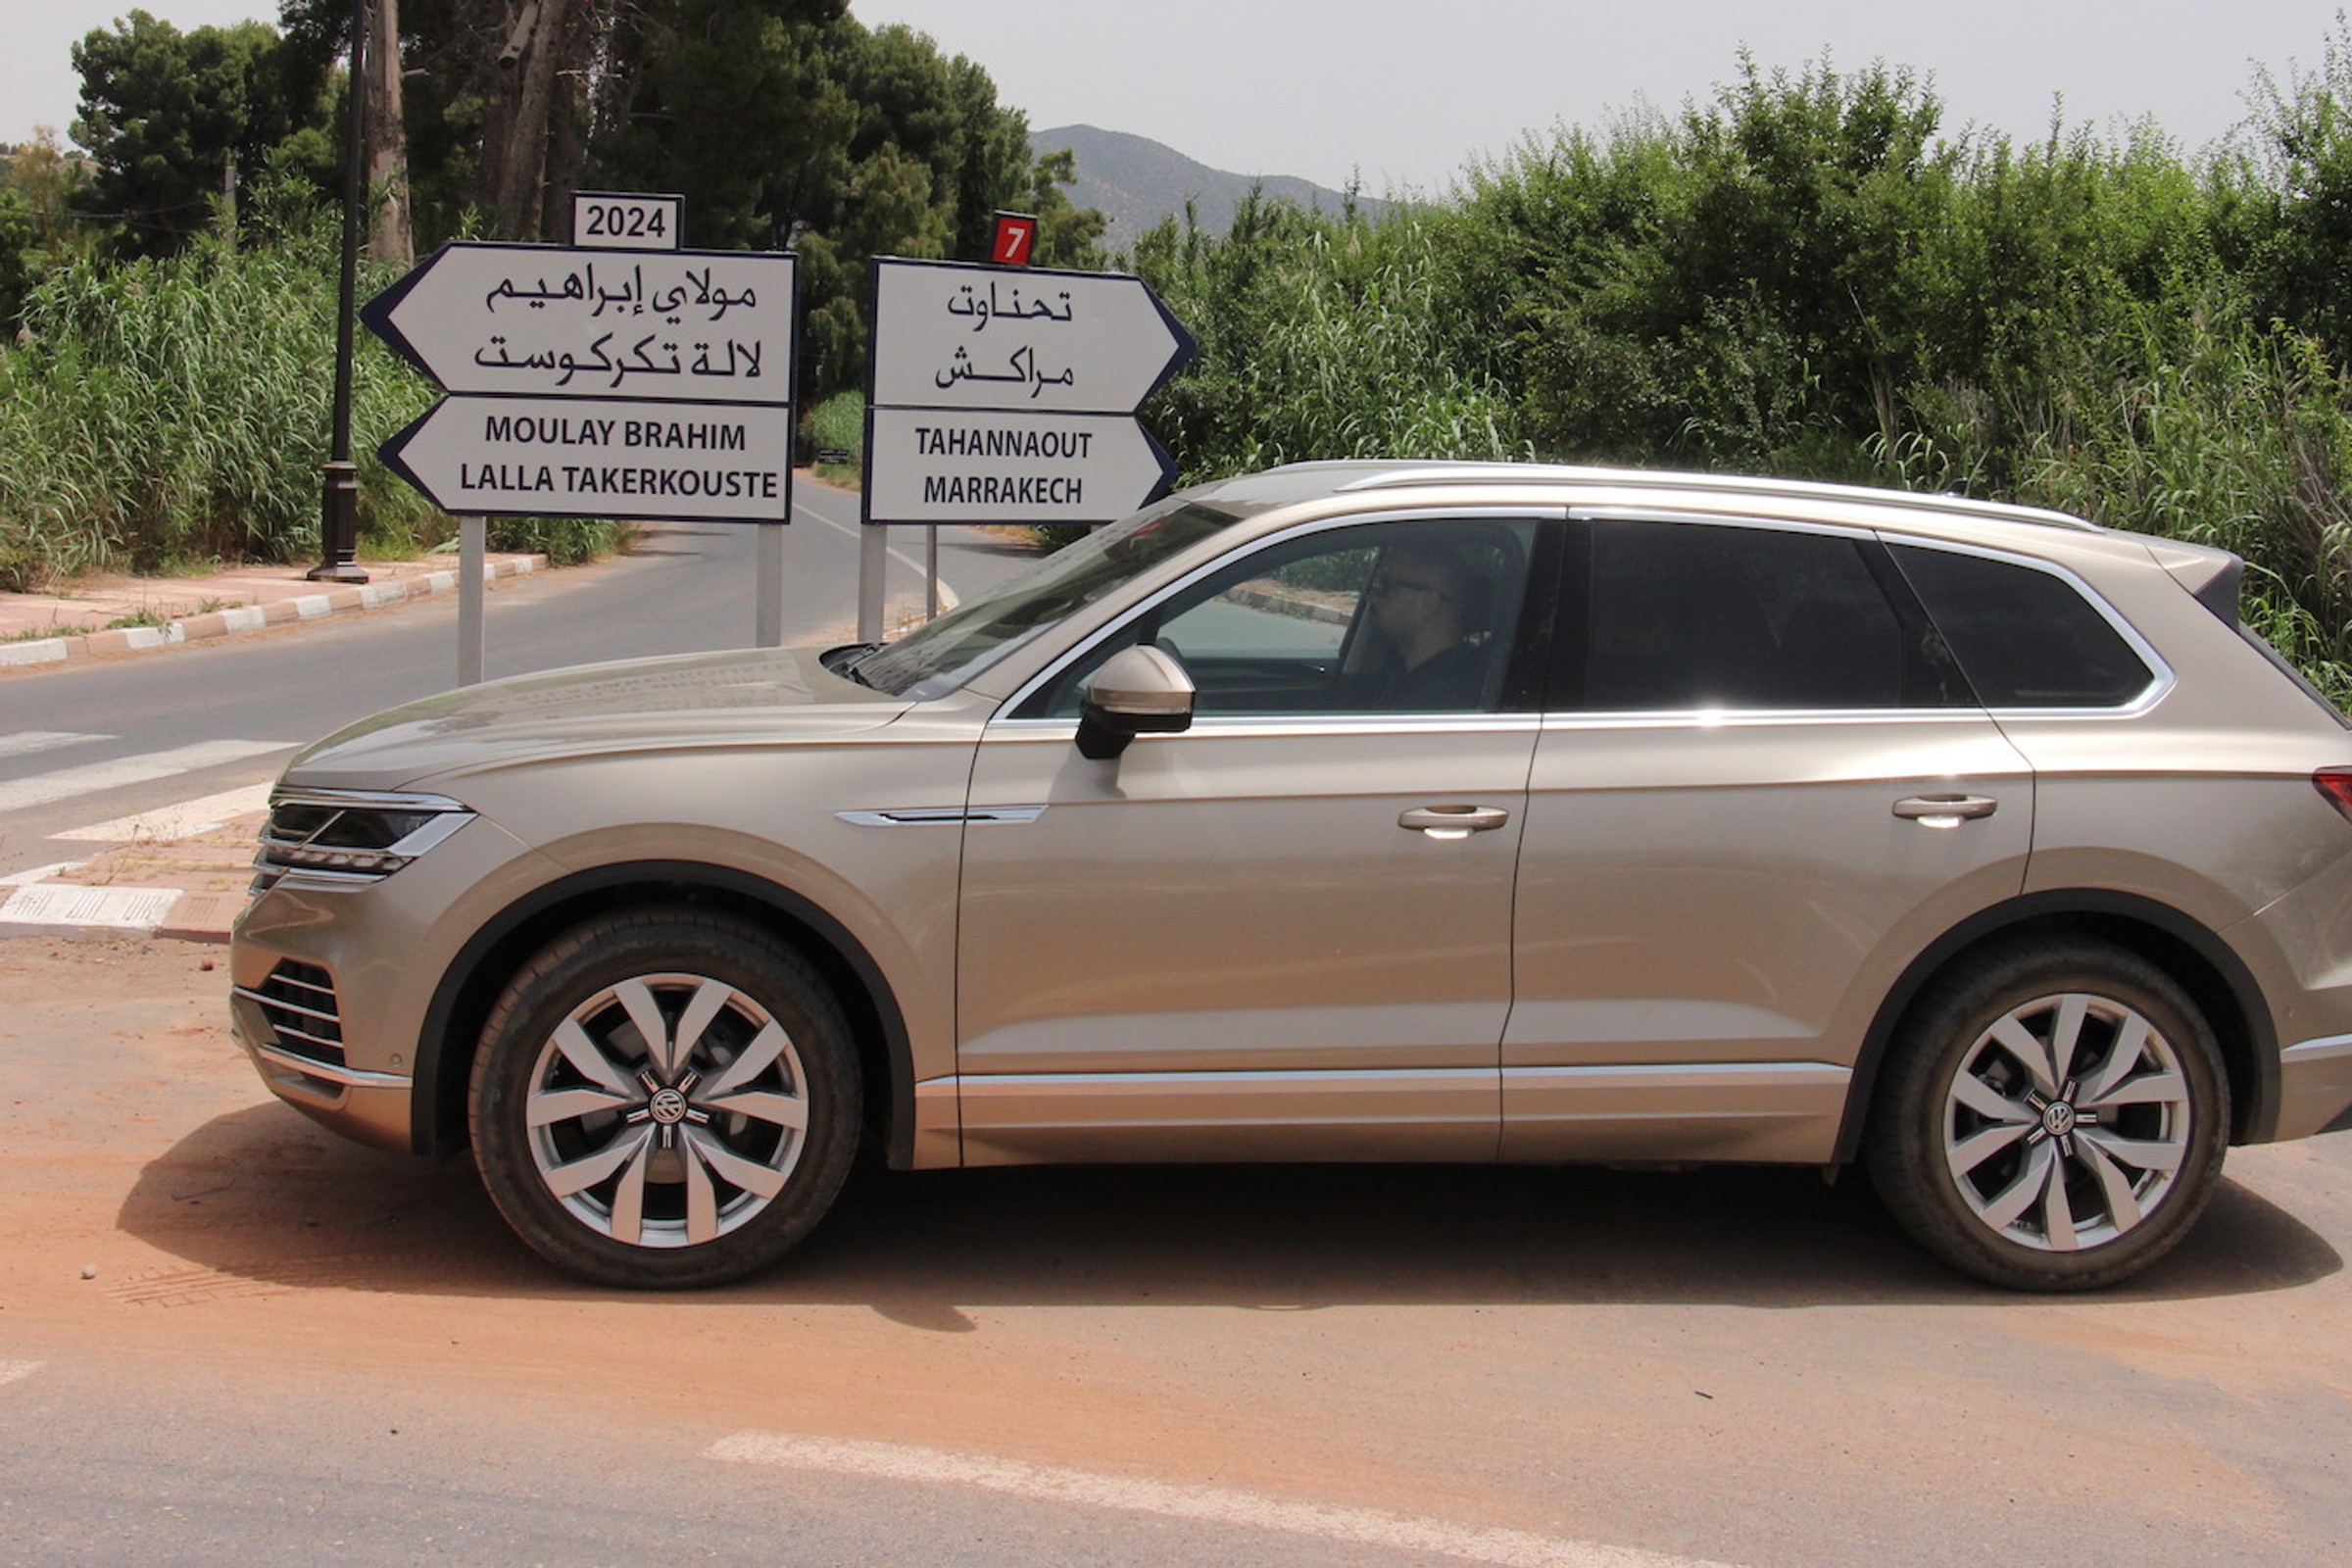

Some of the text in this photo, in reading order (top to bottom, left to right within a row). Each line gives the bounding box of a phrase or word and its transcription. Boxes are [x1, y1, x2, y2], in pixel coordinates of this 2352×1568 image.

[586, 205, 666, 238] 2024
[1004, 227, 1026, 258] 7
[485, 262, 757, 325] مولاي إبراهيم
[947, 280, 1072, 332] تحناوت
[473, 331, 761, 389] لالة تكركوست
[935, 345, 1074, 399] مراكش
[485, 416, 746, 452] MOULAY BRAHIM
[914, 427, 1093, 459] TAHANNAOUT
[461, 463, 777, 499] LALLA TAKERKOUSTE
[924, 475, 1082, 505] MARRAKECH
